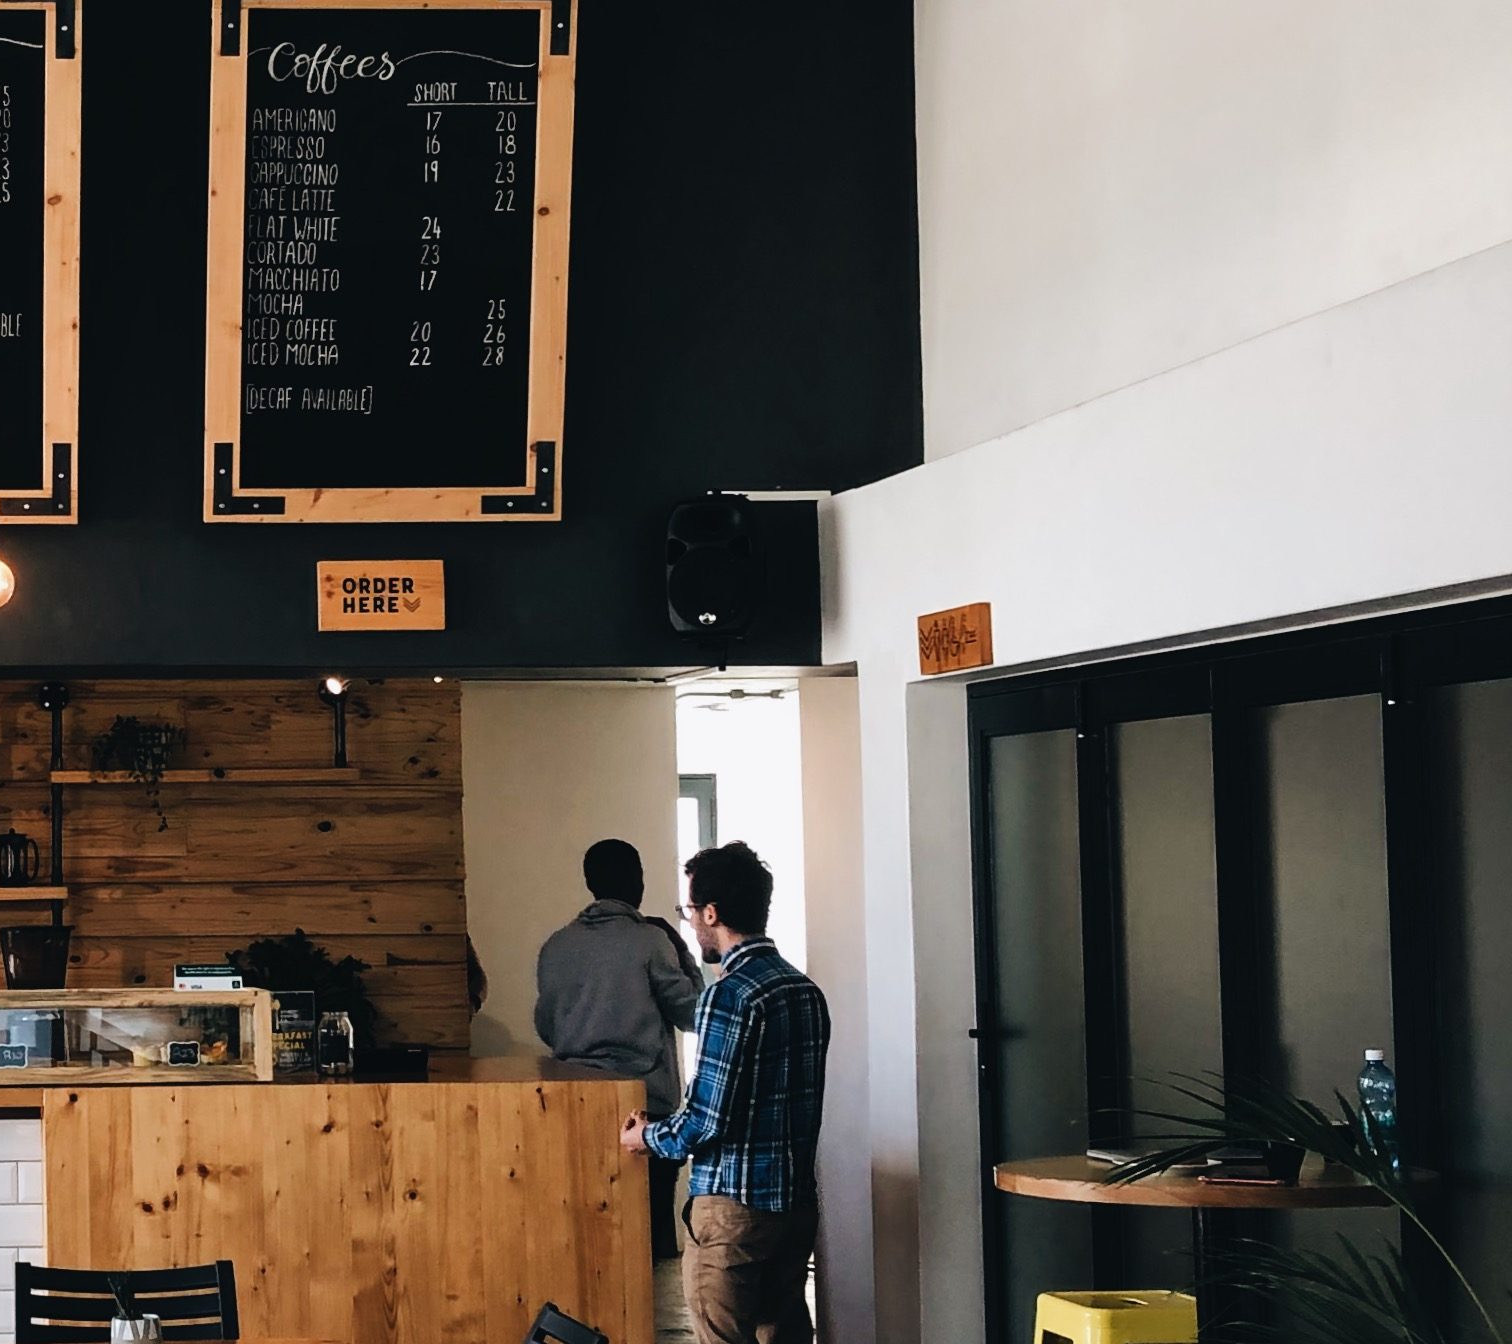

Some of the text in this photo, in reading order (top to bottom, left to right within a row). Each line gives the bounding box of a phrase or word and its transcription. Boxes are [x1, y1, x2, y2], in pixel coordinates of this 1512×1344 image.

[266, 41, 398, 95] Coffees
[414, 81, 528, 103] SHORT TALL
[253, 108, 516, 133] AMERICANO 17 20
[252, 135, 516, 160] ESPRESSO 16 18
[250, 162, 515, 186] CAPPUCCINO 19 23
[292, 189, 336, 212] LATTE
[495, 190, 516, 212] 22
[248, 216, 441, 242] FLAT WHITE 24
[247, 242, 440, 265] CORTADO 23
[248, 268, 437, 292] MACCHIATO 17
[248, 294, 506, 320] MOCHA 25
[248, 318, 506, 344] ICED COFFEE 20 26
[247, 343, 504, 367] ICED MOCHA 22 28
[342, 578, 414, 594] ORDER
[343, 597, 398, 613] HERE
